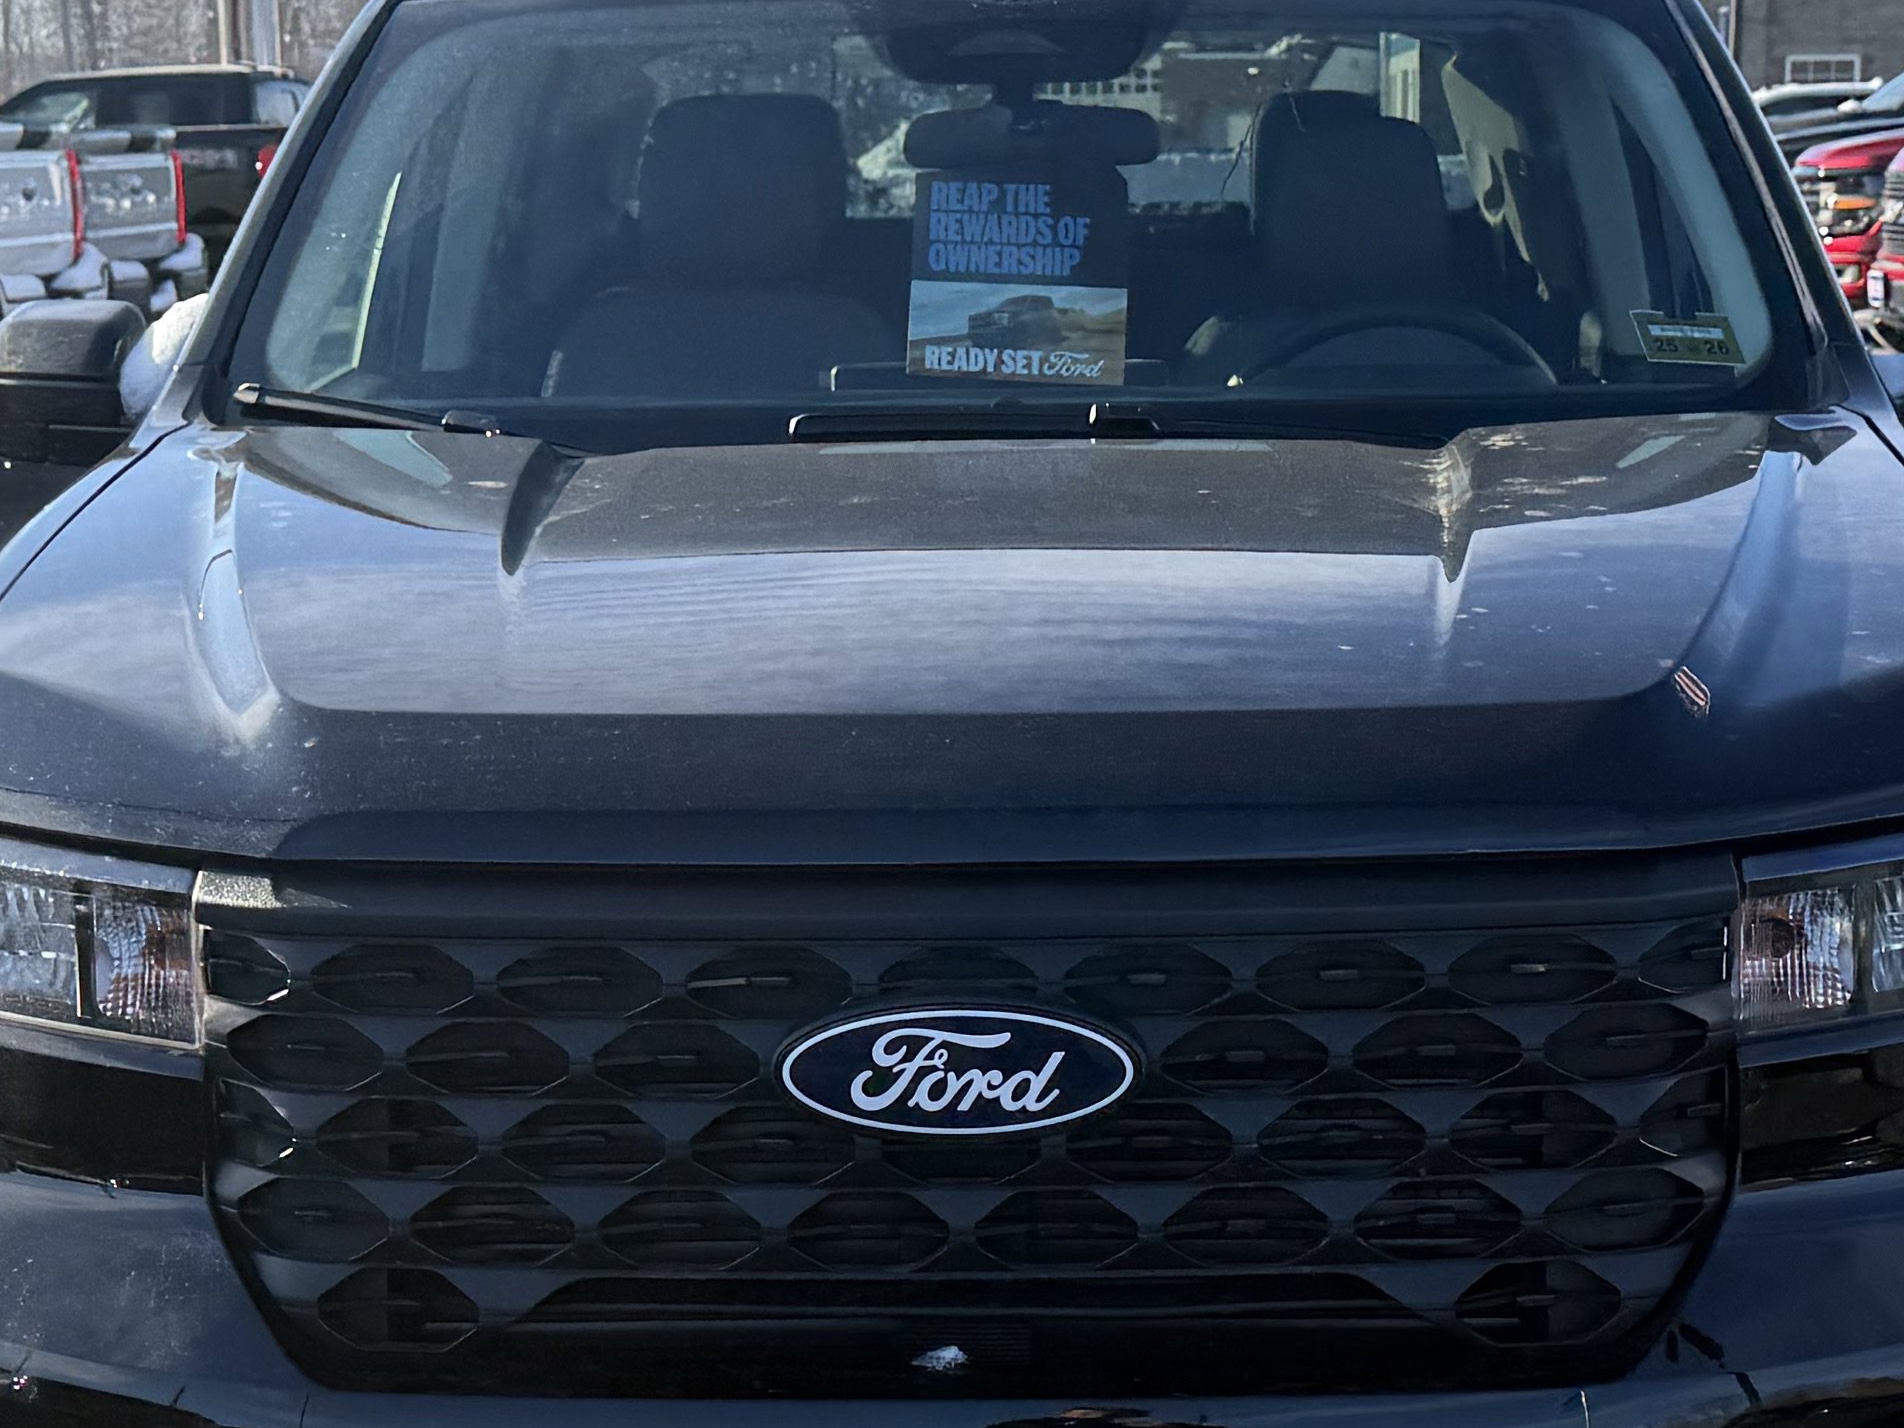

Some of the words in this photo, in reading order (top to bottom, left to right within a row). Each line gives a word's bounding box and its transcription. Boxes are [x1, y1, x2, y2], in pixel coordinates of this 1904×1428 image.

[930, 181, 999, 211] REAP
[1003, 184, 1051, 213] THE
[929, 211, 1054, 245] REWARDS
[1057, 216, 1090, 245] OF
[927, 242, 1081, 277] OWNERSHIP
[925, 345, 998, 373] READY
[1001, 348, 1043, 375] SET
[1045, 351, 1104, 377] Ford
[850, 1027, 1066, 1112] Ford
